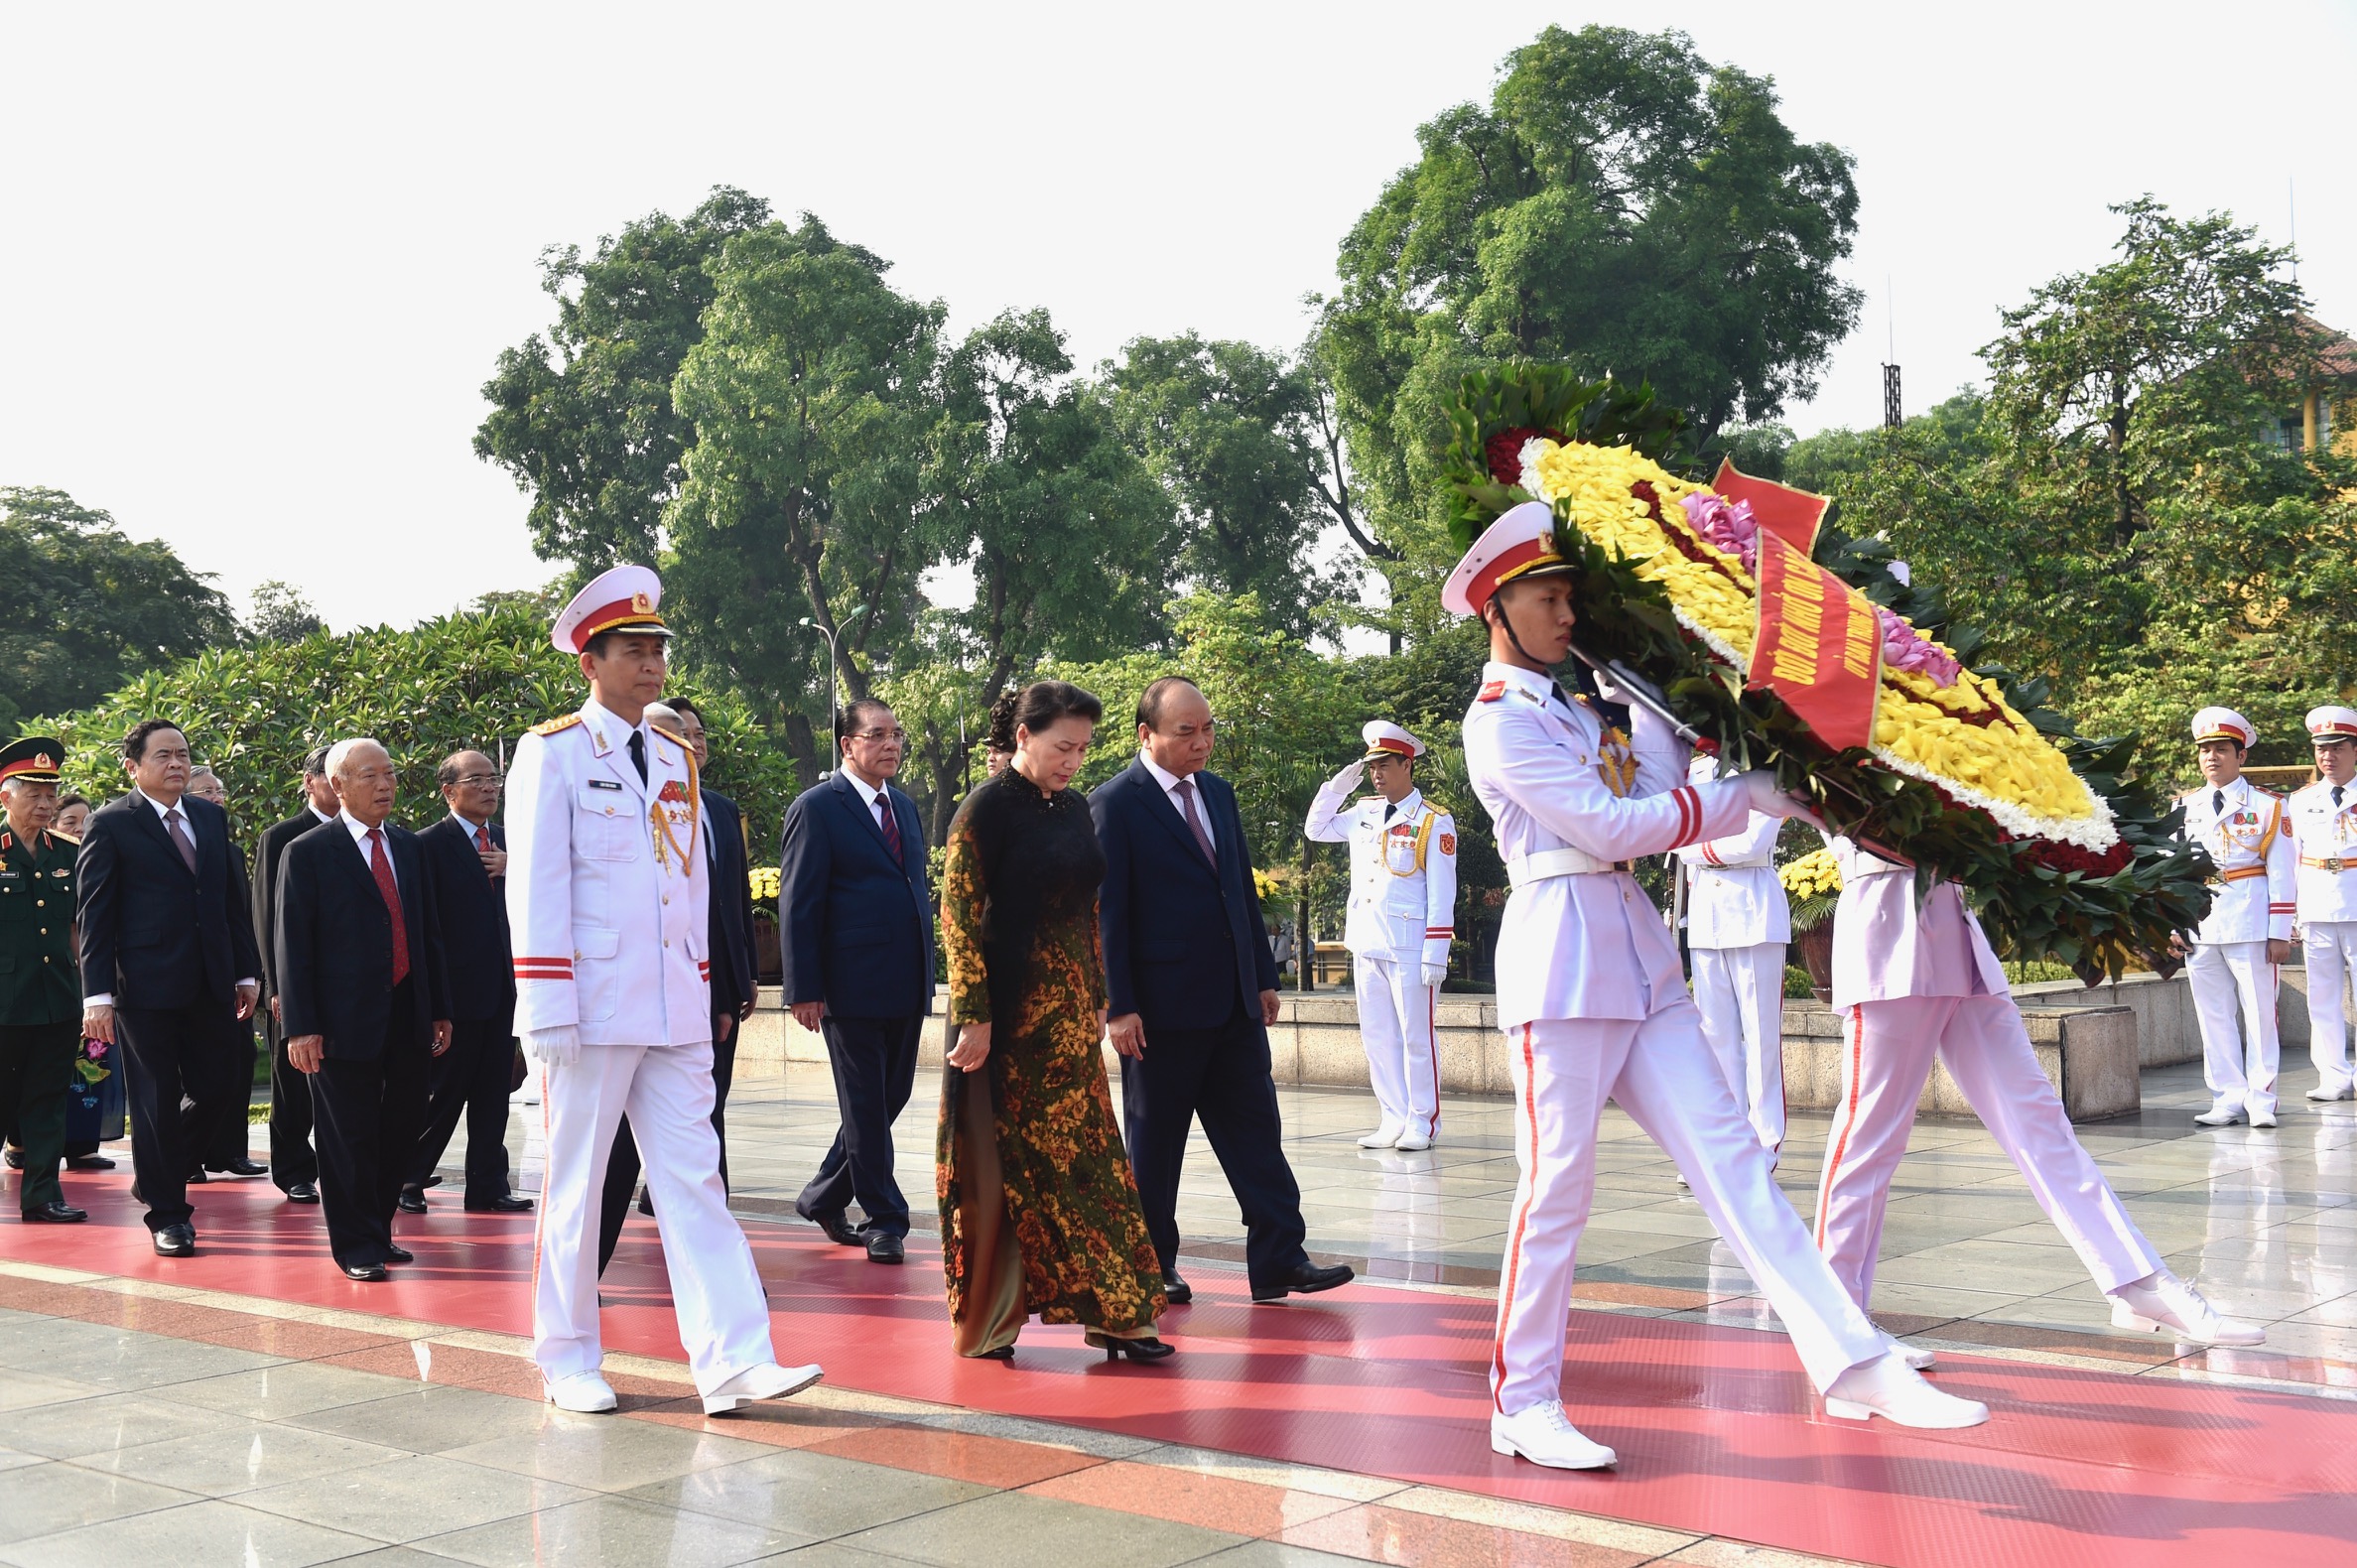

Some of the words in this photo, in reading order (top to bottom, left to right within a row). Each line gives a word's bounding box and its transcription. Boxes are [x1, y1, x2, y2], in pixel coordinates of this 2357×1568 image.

[1781, 573, 1825, 601] ƠN
[1769, 591, 1824, 634] NHỚ
[1846, 610, 1875, 644] TRUNG
[1767, 648, 1818, 686] ĐỜI
[1845, 637, 1873, 665] BAN
